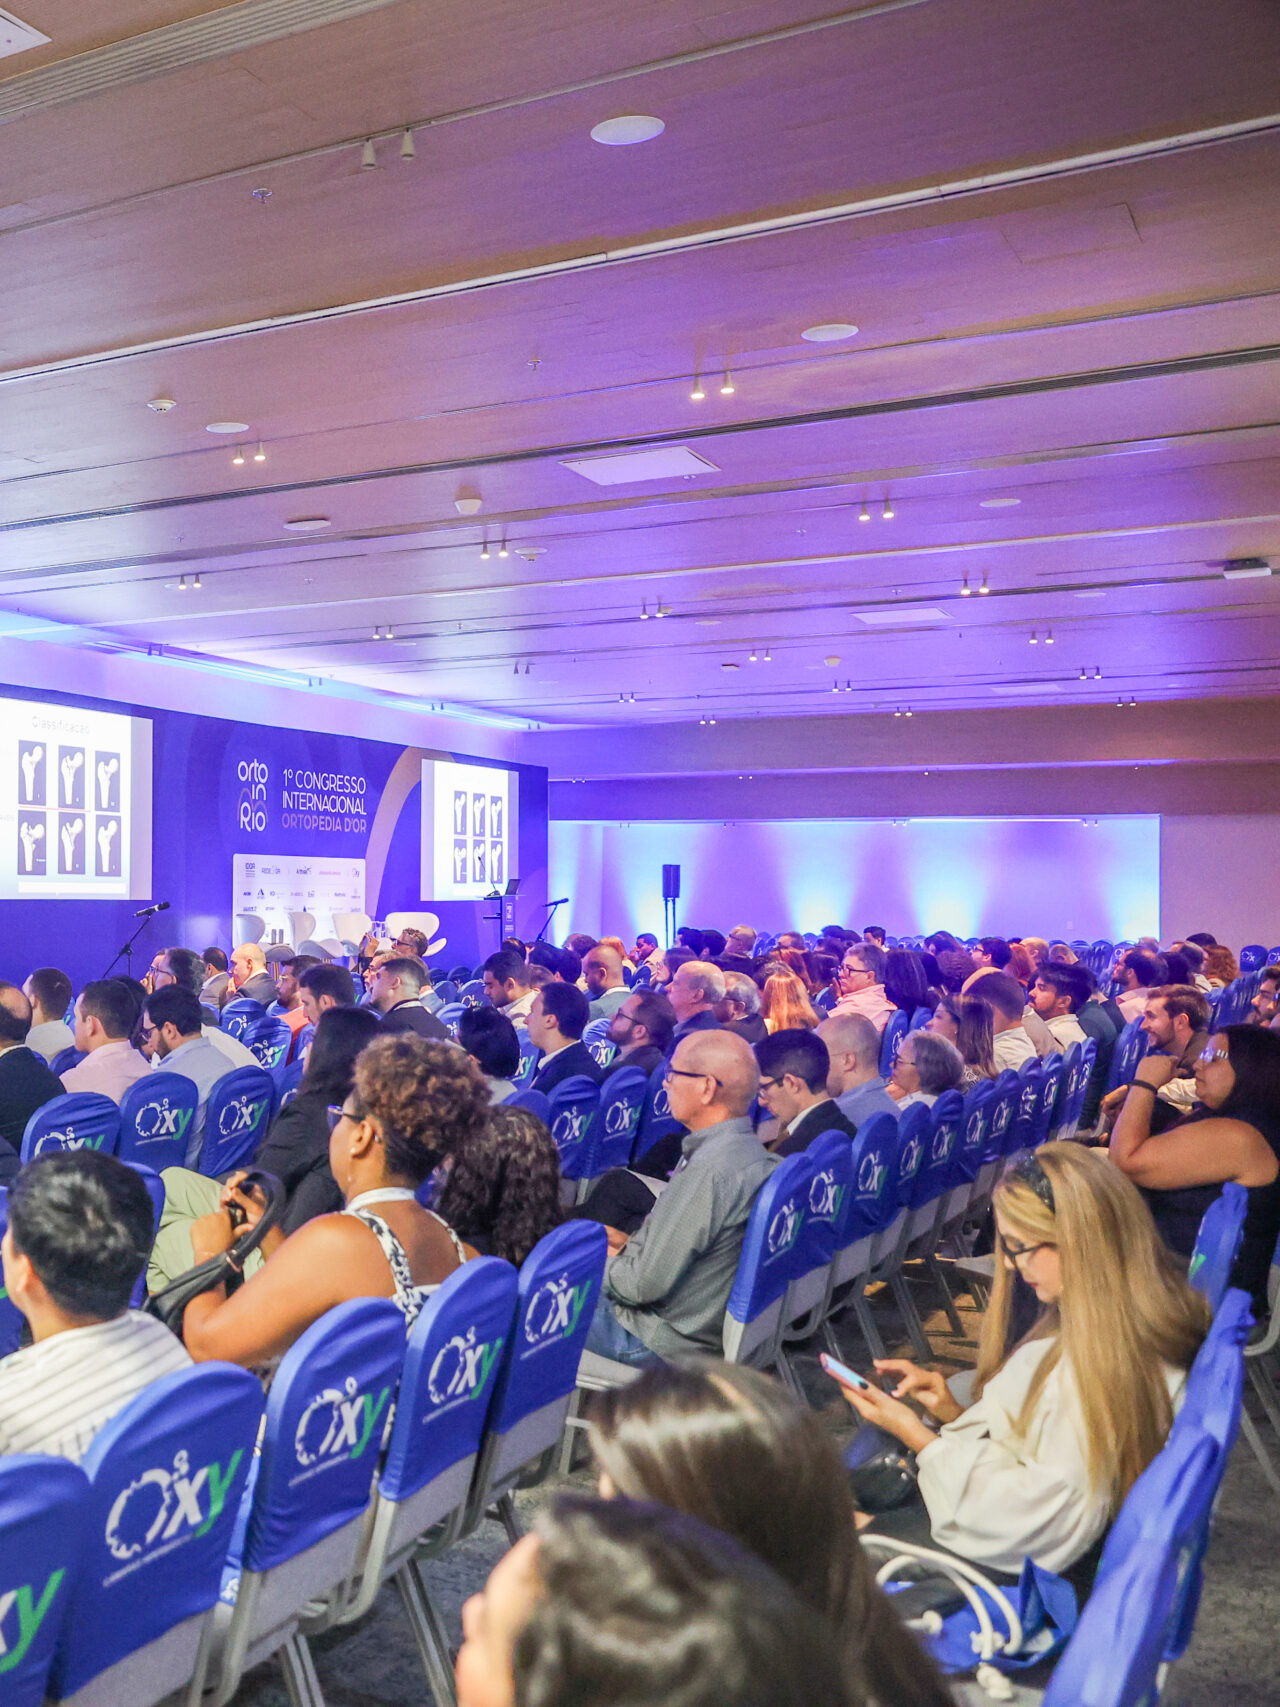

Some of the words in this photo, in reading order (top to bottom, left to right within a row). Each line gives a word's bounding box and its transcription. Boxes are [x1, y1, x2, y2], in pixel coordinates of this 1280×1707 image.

[237, 758, 269, 784] orto
[295, 770, 366, 794] CONGRESSO
[251, 783, 267, 801] in
[282, 790, 367, 816] INTERNACIONAL
[240, 801, 266, 832] Rio
[281, 812, 342, 832] ORTOPEDIA
[344, 818, 367, 833] D'OR
[135, 1101, 193, 1141] Oxy
[219, 1098, 268, 1134] Oxy
[525, 1278, 592, 1343] Oxy
[428, 1335, 503, 1405] Oxy
[295, 1386, 391, 1466] Oxy
[105, 1448, 245, 1560] Oxy
